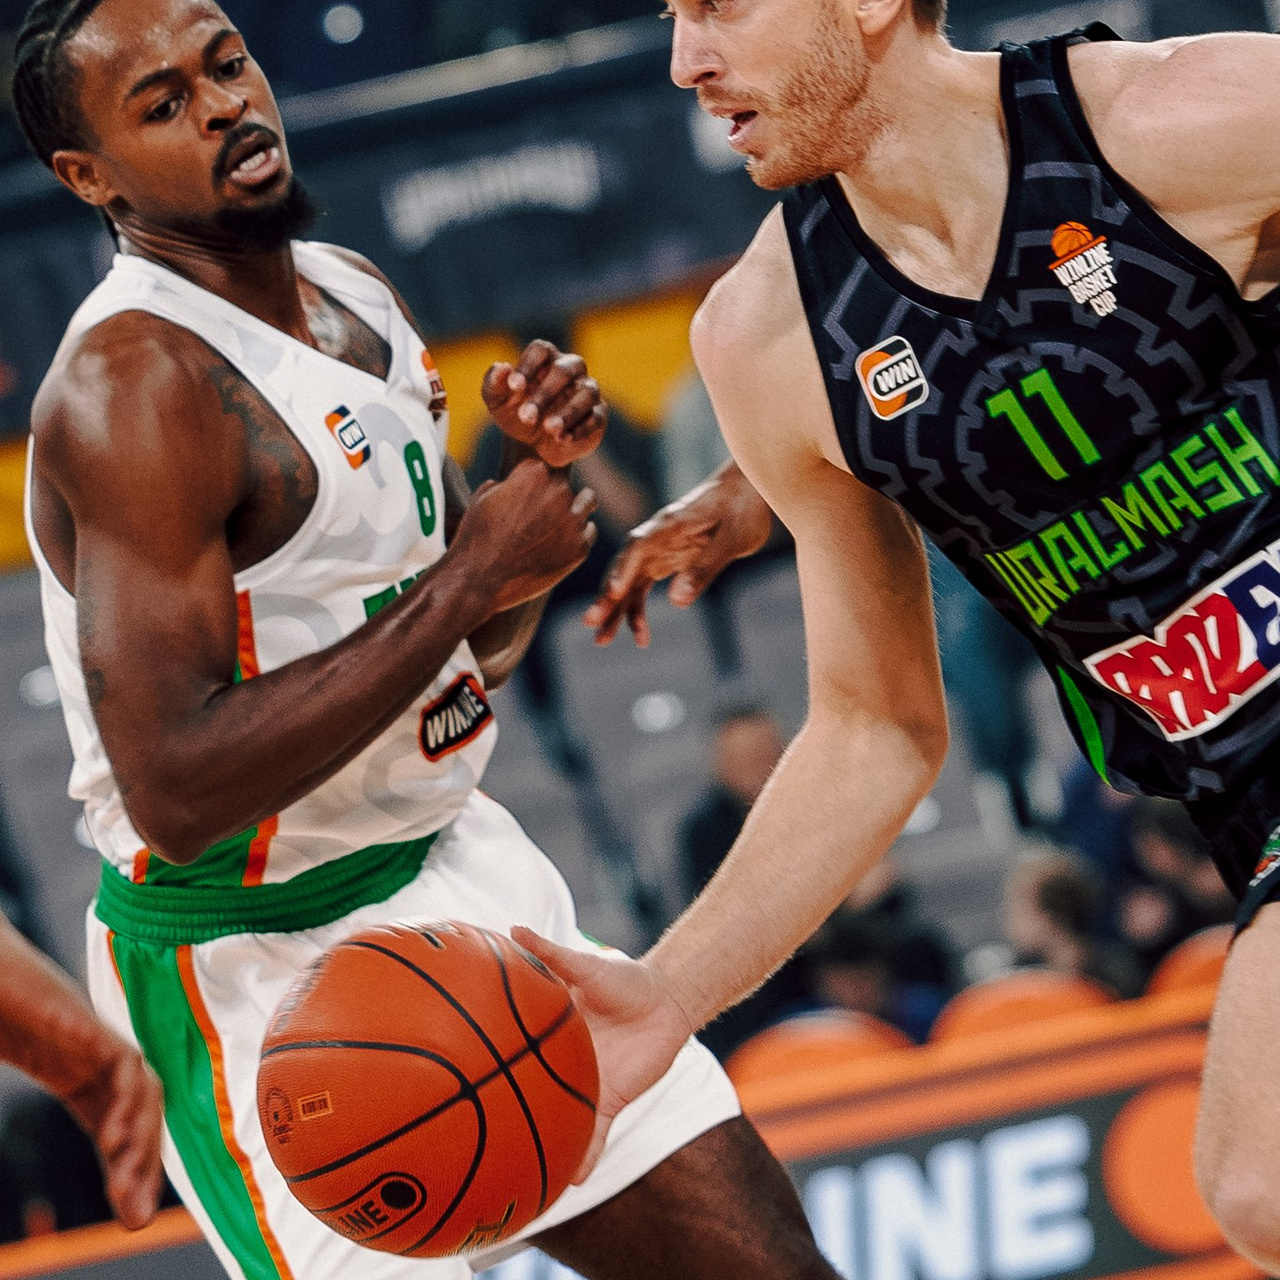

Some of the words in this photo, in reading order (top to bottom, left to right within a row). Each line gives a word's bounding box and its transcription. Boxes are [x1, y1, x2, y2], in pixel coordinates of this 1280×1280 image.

[1053, 242, 1114, 287] WINLINE
[1068, 264, 1118, 305] BASKET
[1089, 289, 1118, 317] CUP
[875, 358, 917, 393] WIN
[986, 369, 1101, 481] 11
[404, 440, 436, 538] 8
